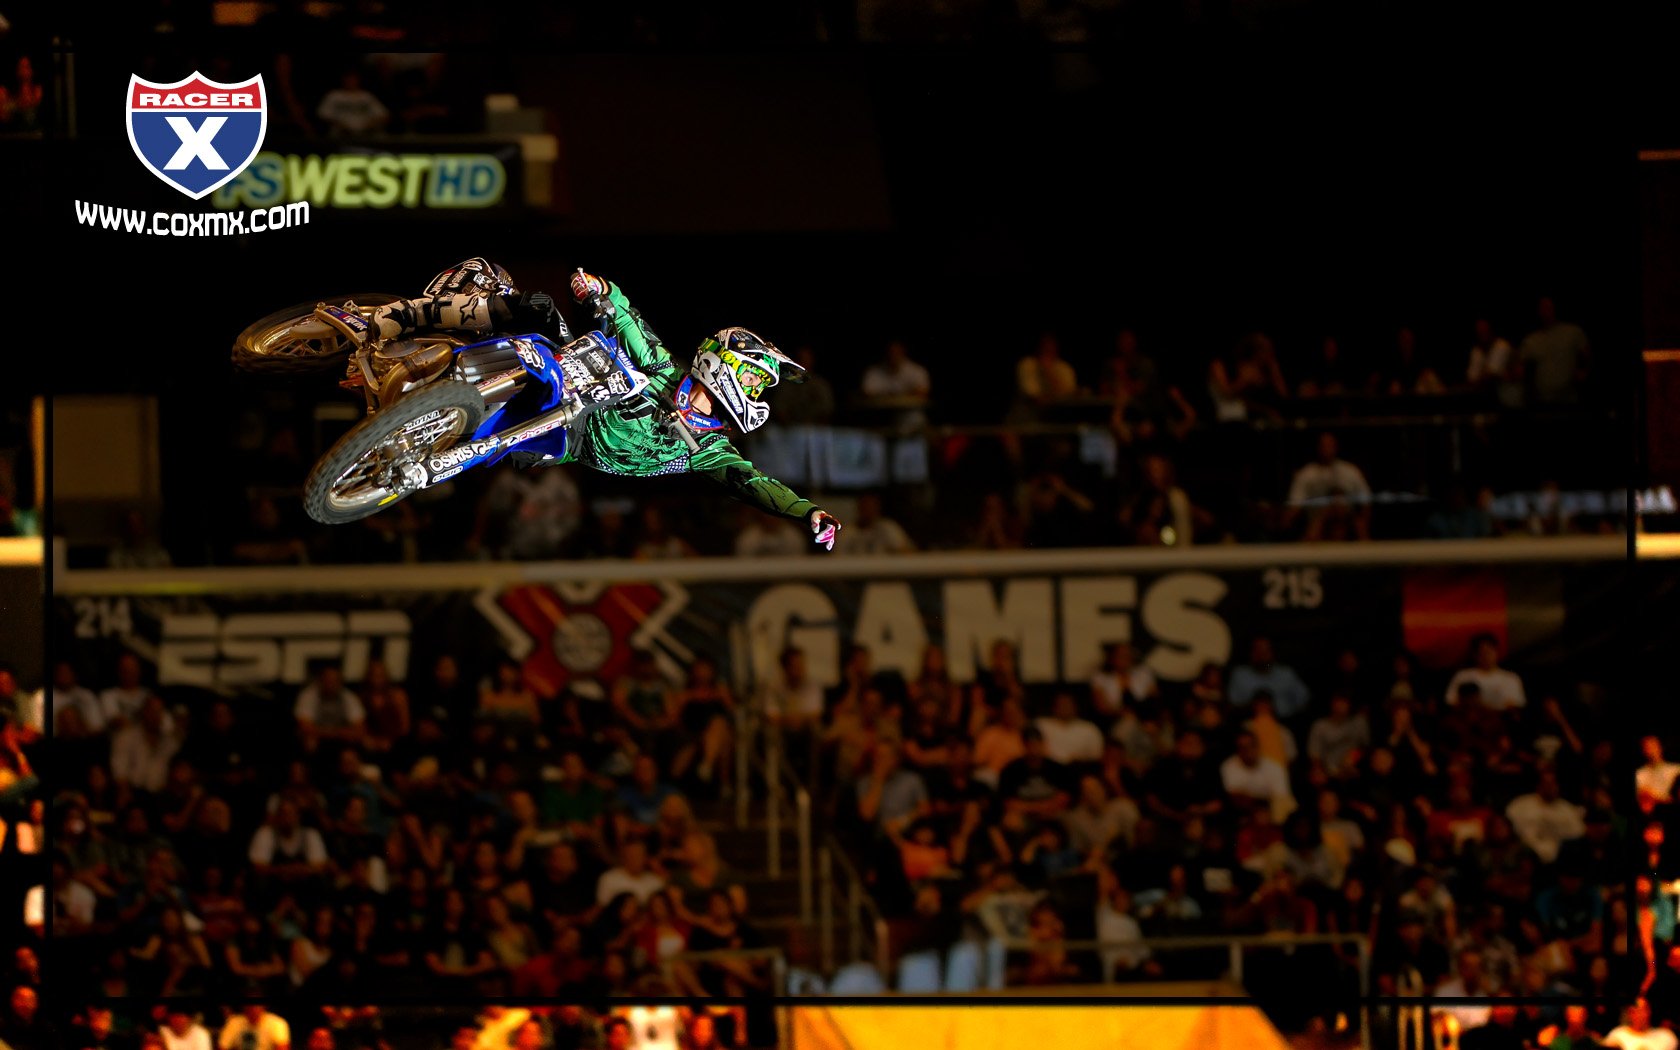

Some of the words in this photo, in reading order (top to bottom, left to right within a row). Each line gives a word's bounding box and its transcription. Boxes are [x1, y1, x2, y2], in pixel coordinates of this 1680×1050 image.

[429, 444, 474, 472] OSIRIS
[1263, 569, 1324, 609] 215
[74, 599, 133, 639] 214
[158, 611, 411, 685] ESPN
[746, 571, 1232, 685] GAMES
